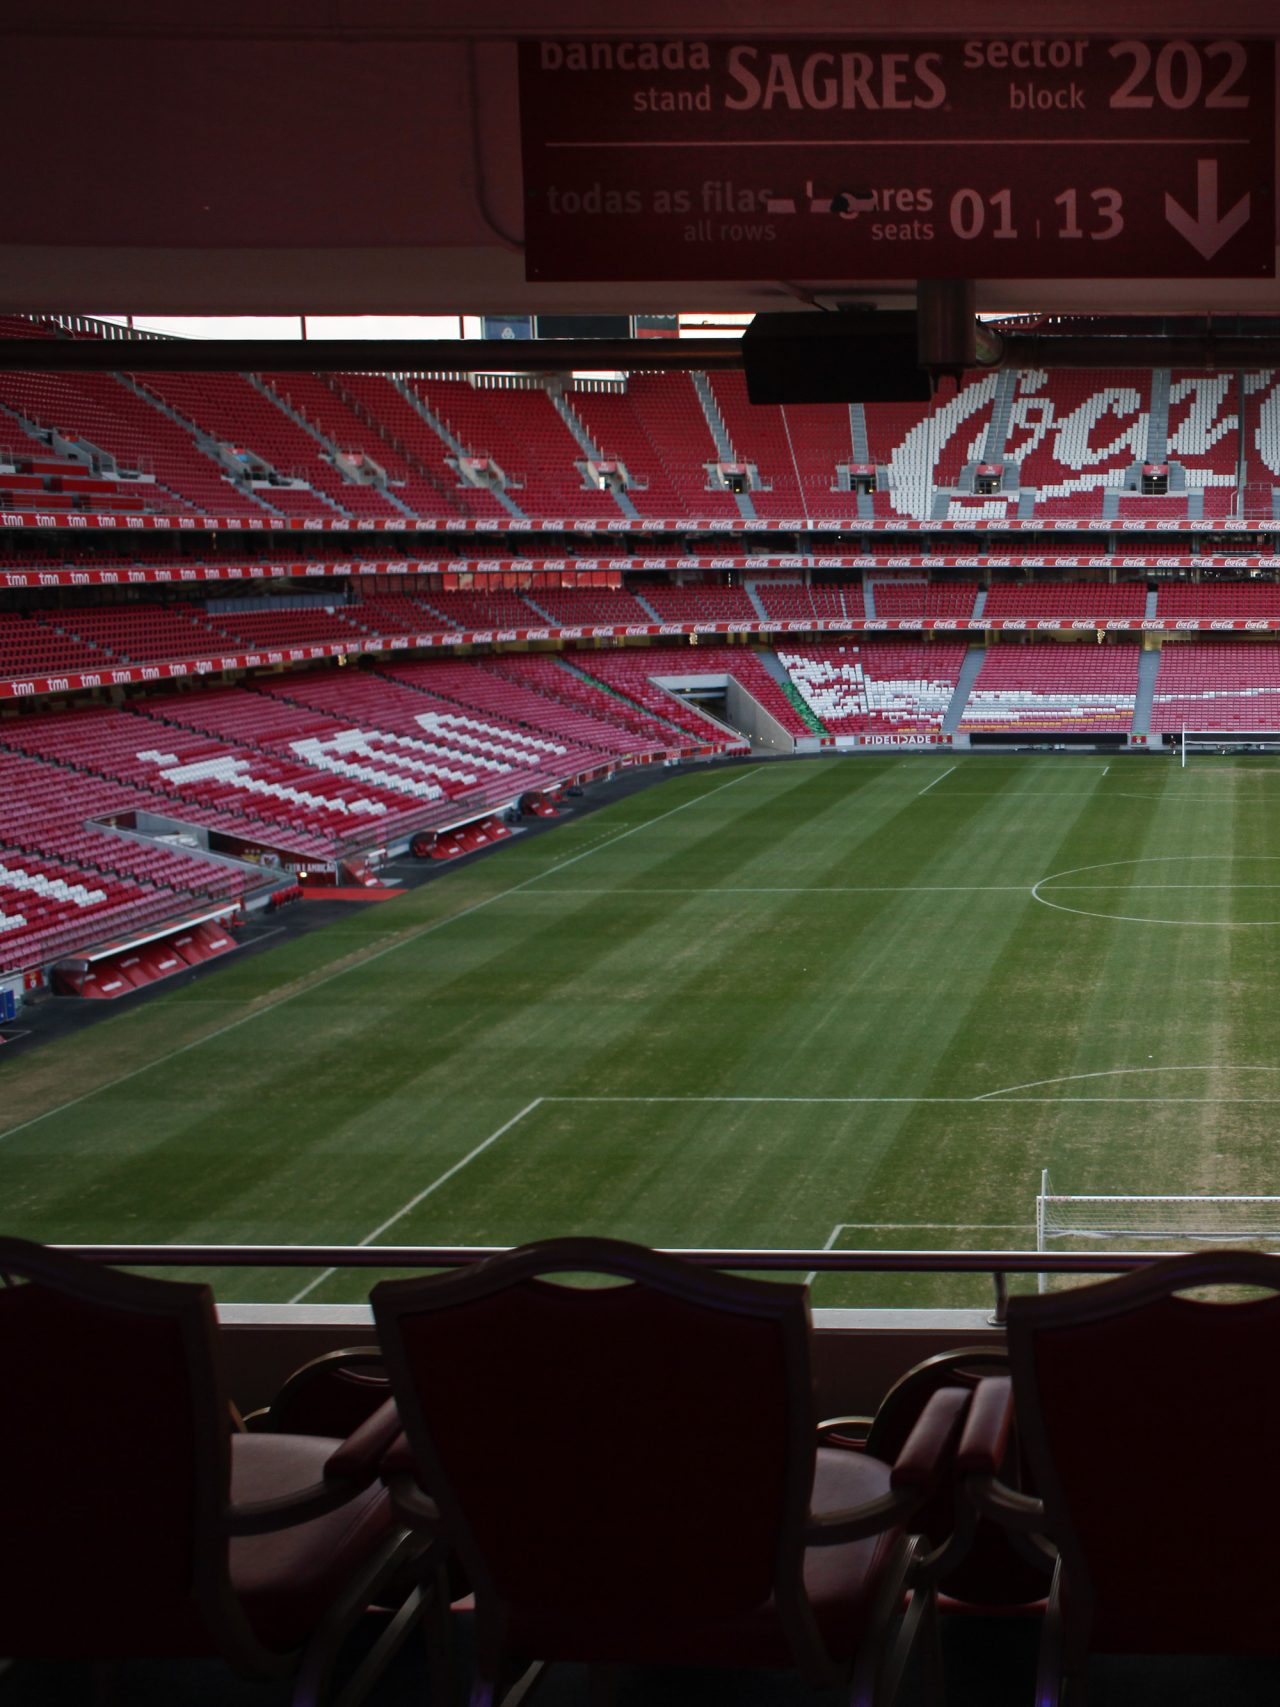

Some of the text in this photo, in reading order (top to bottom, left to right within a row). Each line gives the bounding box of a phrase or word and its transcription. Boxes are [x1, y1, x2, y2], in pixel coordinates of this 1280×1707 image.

[541, 41, 711, 71] bancada
[963, 40, 1090, 69] sector
[724, 45, 947, 111] SAGRES
[1108, 40, 1250, 110] 202
[633, 85, 712, 112] stand
[1009, 82, 1086, 110] block
[547, 183, 643, 215] todas
[653, 190, 691, 214] as
[949, 186, 1125, 241] 01 13
[683, 220, 777, 242] all rows
[871, 219, 935, 242] seats
[3, 514, 23, 527] tmn
[36, 514, 56, 527] tmn
[68, 515, 87, 527] tmn
[98, 515, 115, 527] tmn
[126, 516, 143, 528] tmn
[153, 516, 170, 528] tmn
[6, 571, 27, 586] tmn
[38, 571, 59, 584] tmn
[70, 570, 89, 583] tmn
[99, 570, 118, 582] tmn
[127, 569, 145, 581] tmn
[154, 569, 171, 581] tmn
[11, 679, 34, 695] tmn
[47, 675, 68, 691] tmn
[80, 671, 100, 687] tmn
[111, 668, 131, 683] tmn
[141, 664, 159, 680] tmn
[169, 661, 186, 677] tmn
[194, 658, 212, 674] tmn
[865, 736, 931, 744] FIDELIDADE
